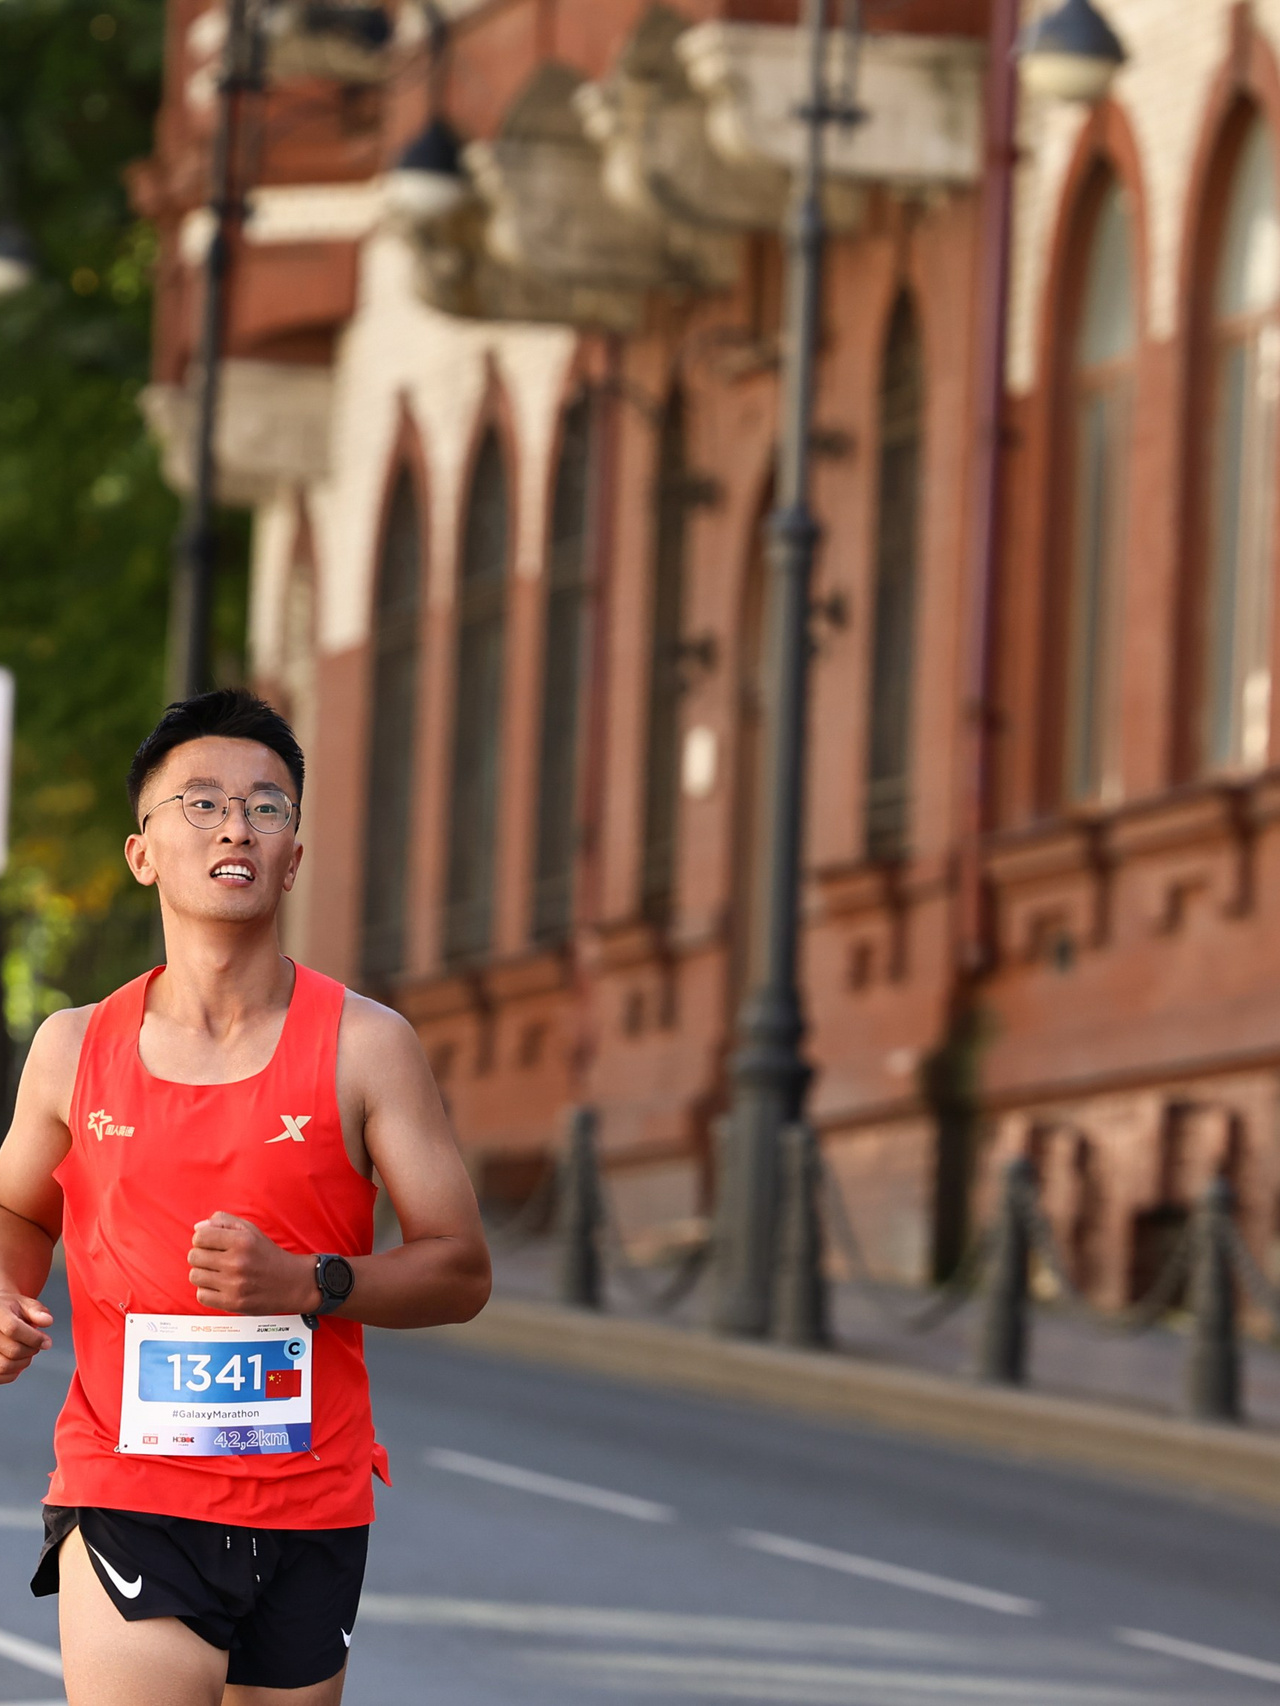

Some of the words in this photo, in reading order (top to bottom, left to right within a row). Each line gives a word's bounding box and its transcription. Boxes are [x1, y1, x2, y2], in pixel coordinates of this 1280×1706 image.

[288, 1342, 300, 1355] C
[167, 1353, 262, 1391] 1341
[172, 1410, 260, 1420] #GalaxyMarathon
[214, 1429, 289, 1450] 42,2km
